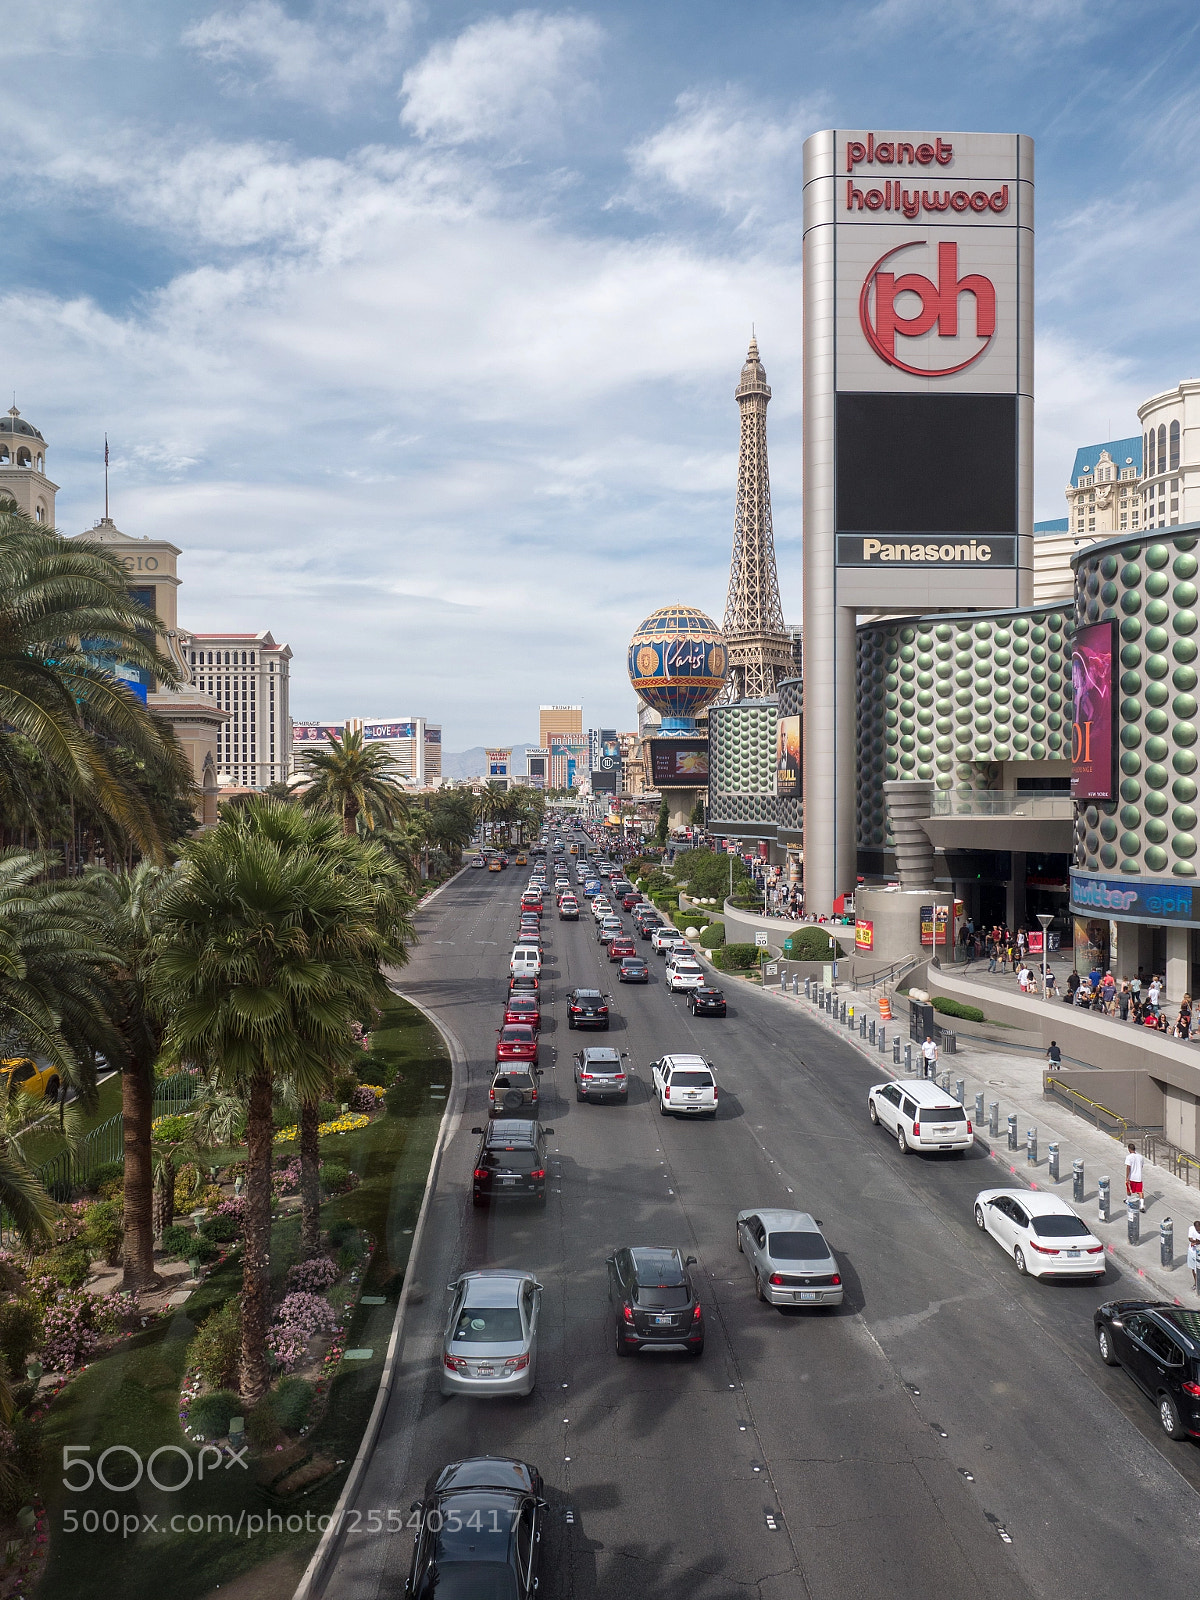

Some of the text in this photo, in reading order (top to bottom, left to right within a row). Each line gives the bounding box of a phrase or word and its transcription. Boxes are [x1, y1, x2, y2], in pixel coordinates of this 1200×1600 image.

[846, 132, 953, 173] planet
[846, 180, 1009, 219] hollywood
[875, 241, 996, 357] ph
[863, 538, 992, 562] Panasonic
[664, 633, 706, 681] Paris
[372, 726, 392, 737] LOVE
[1072, 878, 1138, 911] twitter
